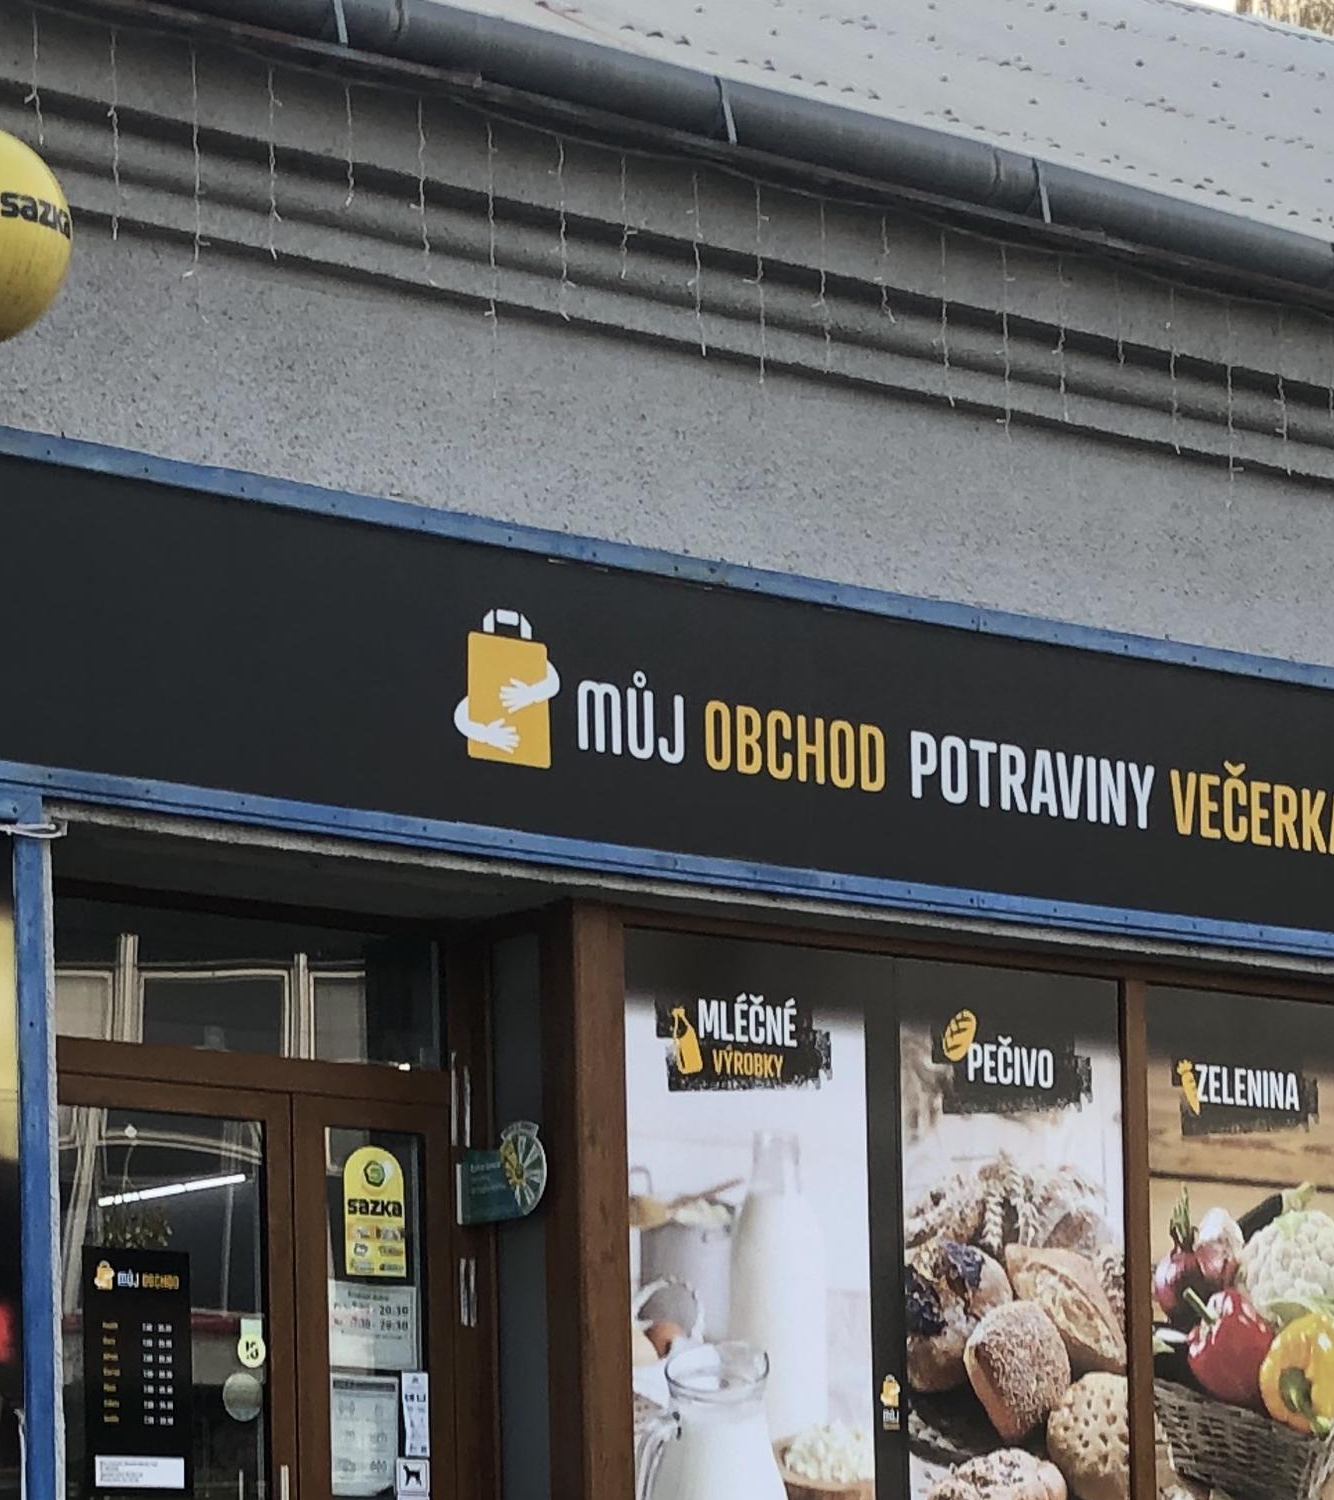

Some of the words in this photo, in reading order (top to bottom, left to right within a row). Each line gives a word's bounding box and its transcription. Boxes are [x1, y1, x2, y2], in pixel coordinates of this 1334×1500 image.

[577, 671, 685, 765] MŮJ
[704, 699, 886, 793] OBCHOD
[909, 729, 1156, 831] POTRAVINY
[697, 993, 799, 1048] MLÉČNÉ
[712, 1046, 785, 1080] VÝROBKY
[968, 1034, 1054, 1090] PEČIVO
[1194, 1062, 1301, 1113] ZELENINA
[347, 1198, 403, 1218] sazka
